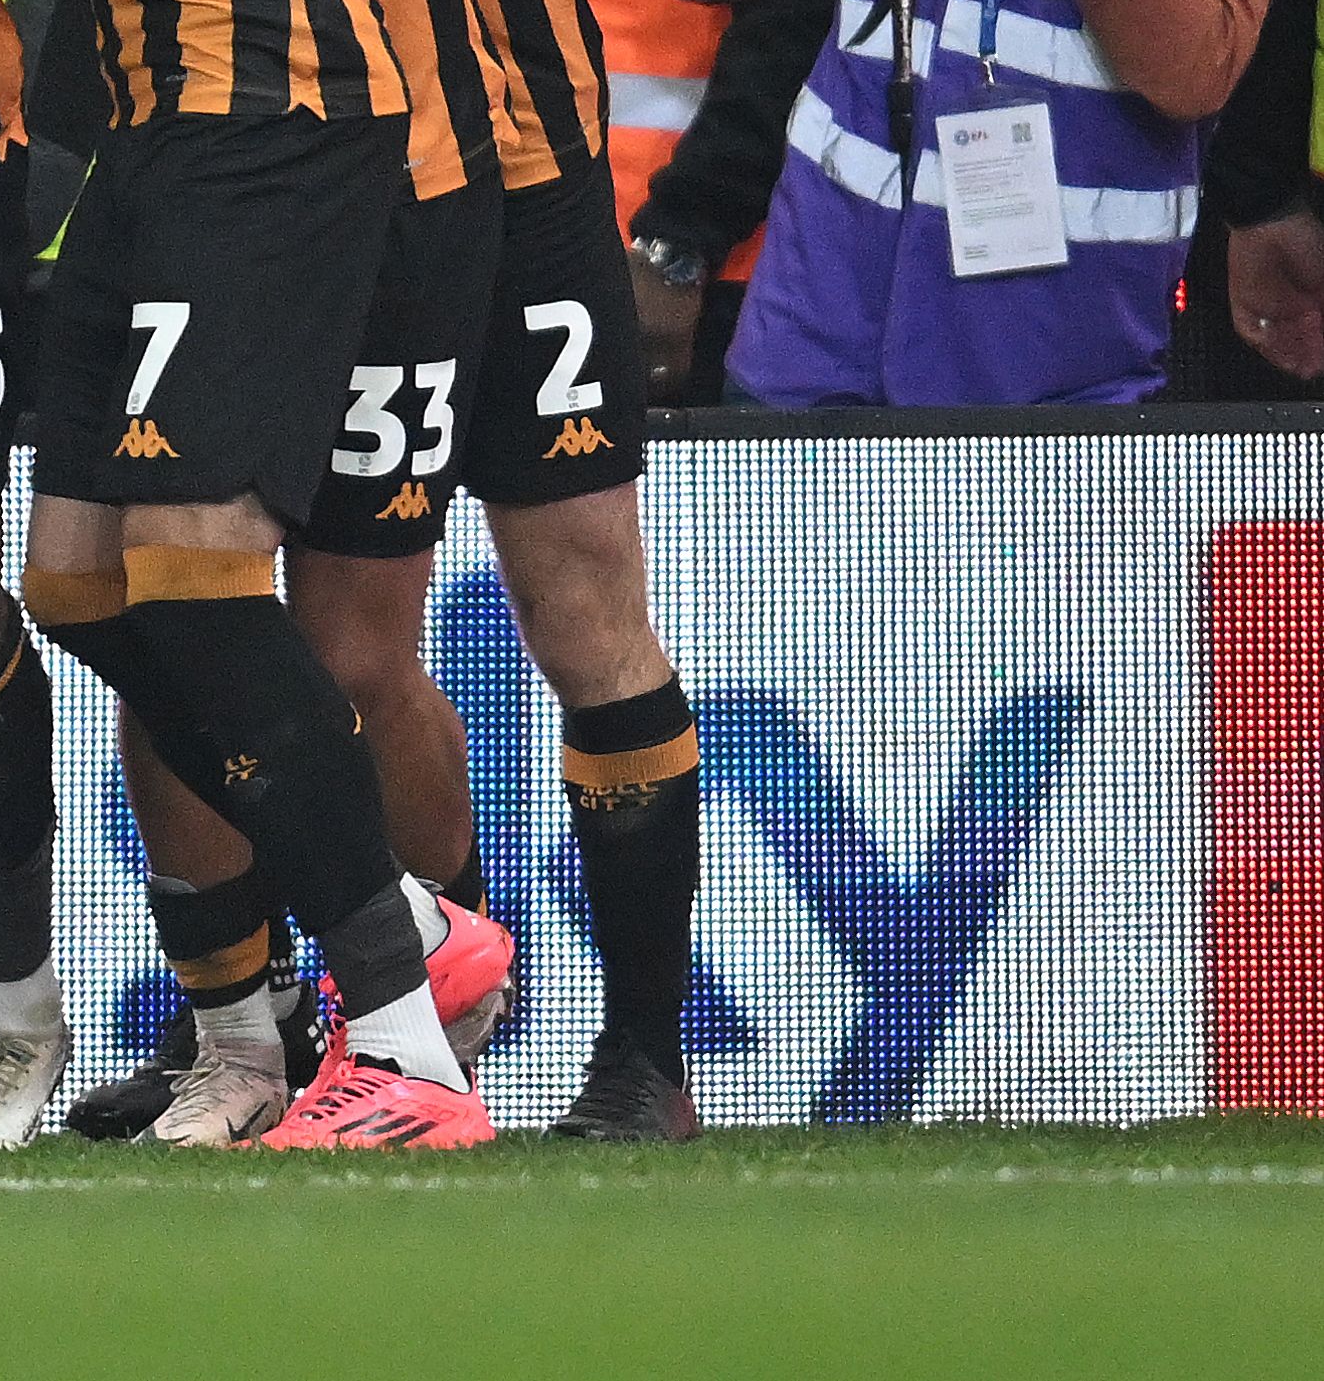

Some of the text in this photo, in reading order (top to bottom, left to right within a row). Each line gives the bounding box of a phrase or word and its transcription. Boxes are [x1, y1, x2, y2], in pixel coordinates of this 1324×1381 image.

[125, 302, 190, 415] 7
[523, 300, 602, 416] 2
[331, 358, 456, 476] 33
[107, 570, 1089, 1126] ky
